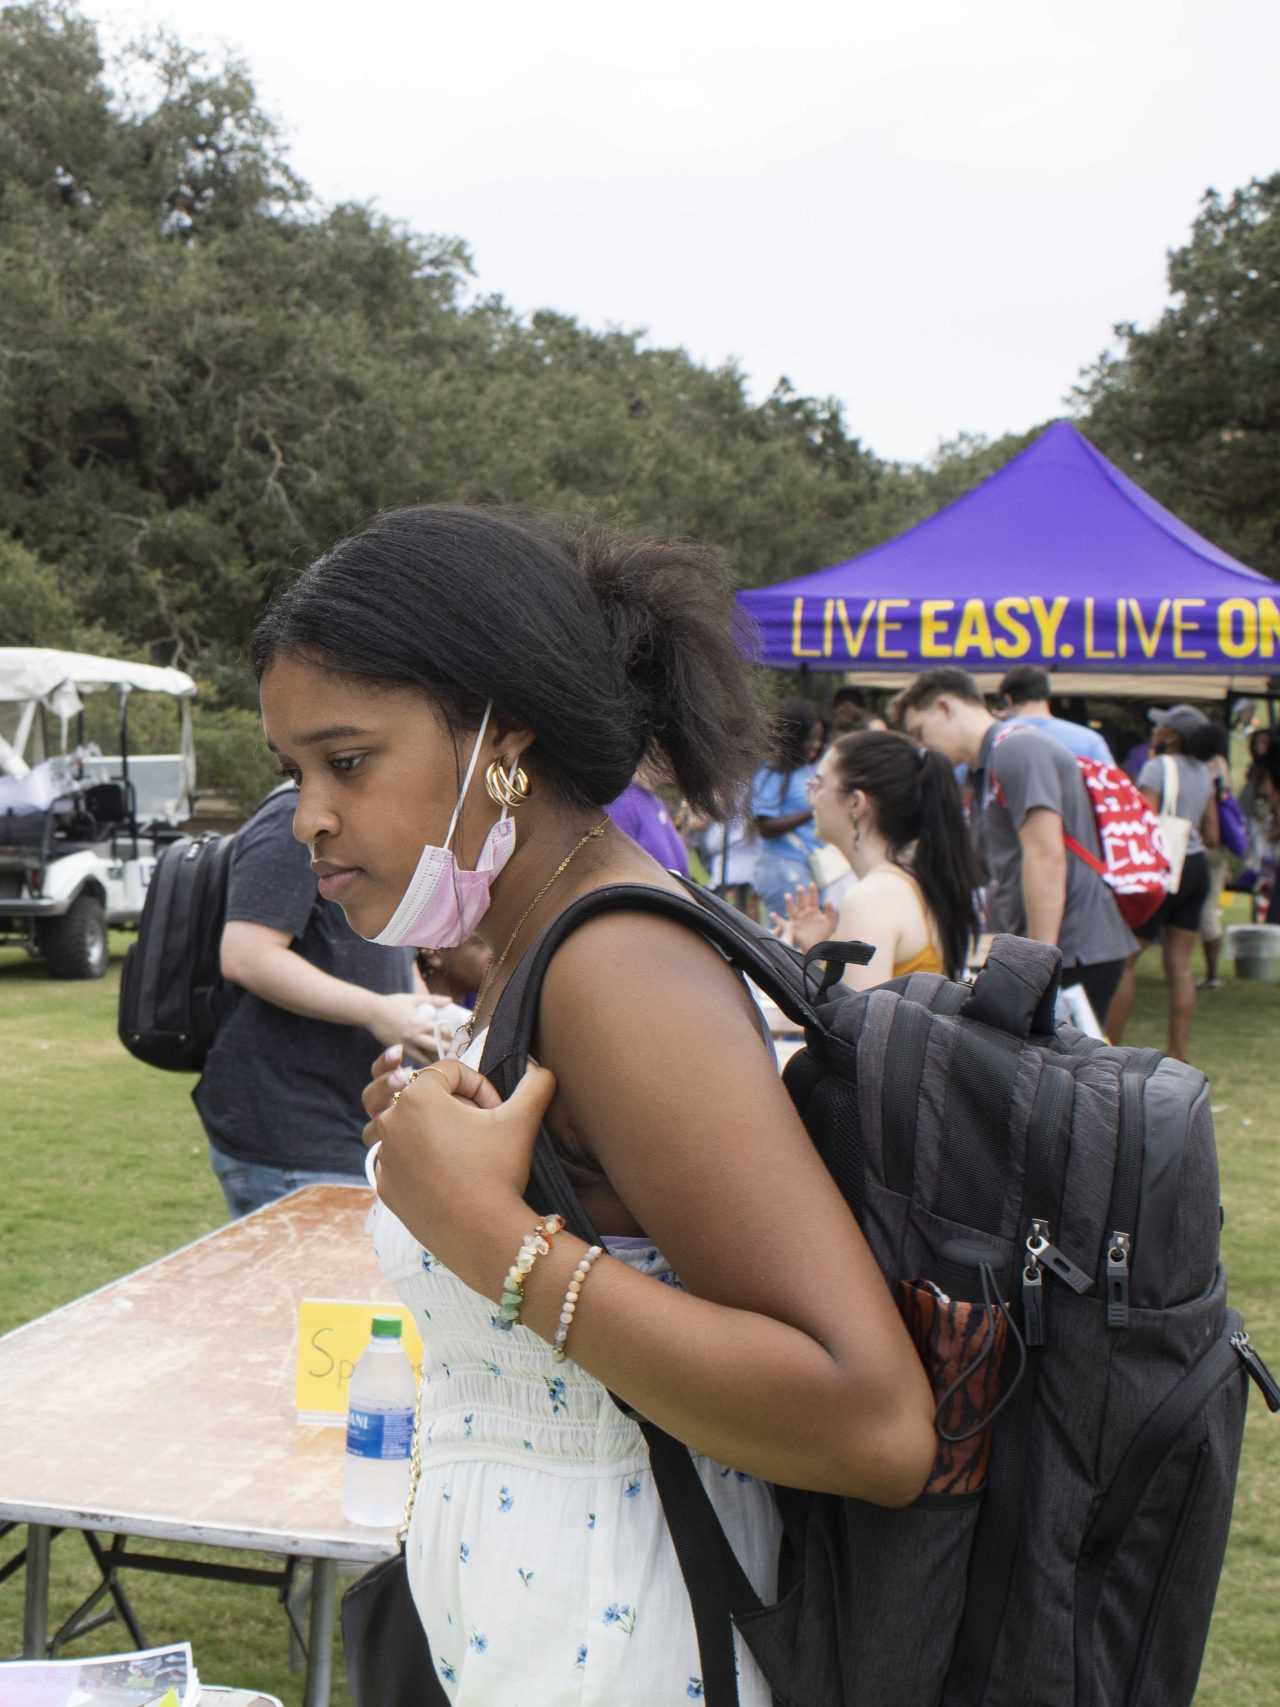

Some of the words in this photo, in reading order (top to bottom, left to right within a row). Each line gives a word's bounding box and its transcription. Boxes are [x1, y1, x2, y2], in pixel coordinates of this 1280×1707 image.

[791, 597, 910, 658] LIVE
[920, 596, 1074, 658] EASY.
[1084, 597, 1207, 658] LIVE
